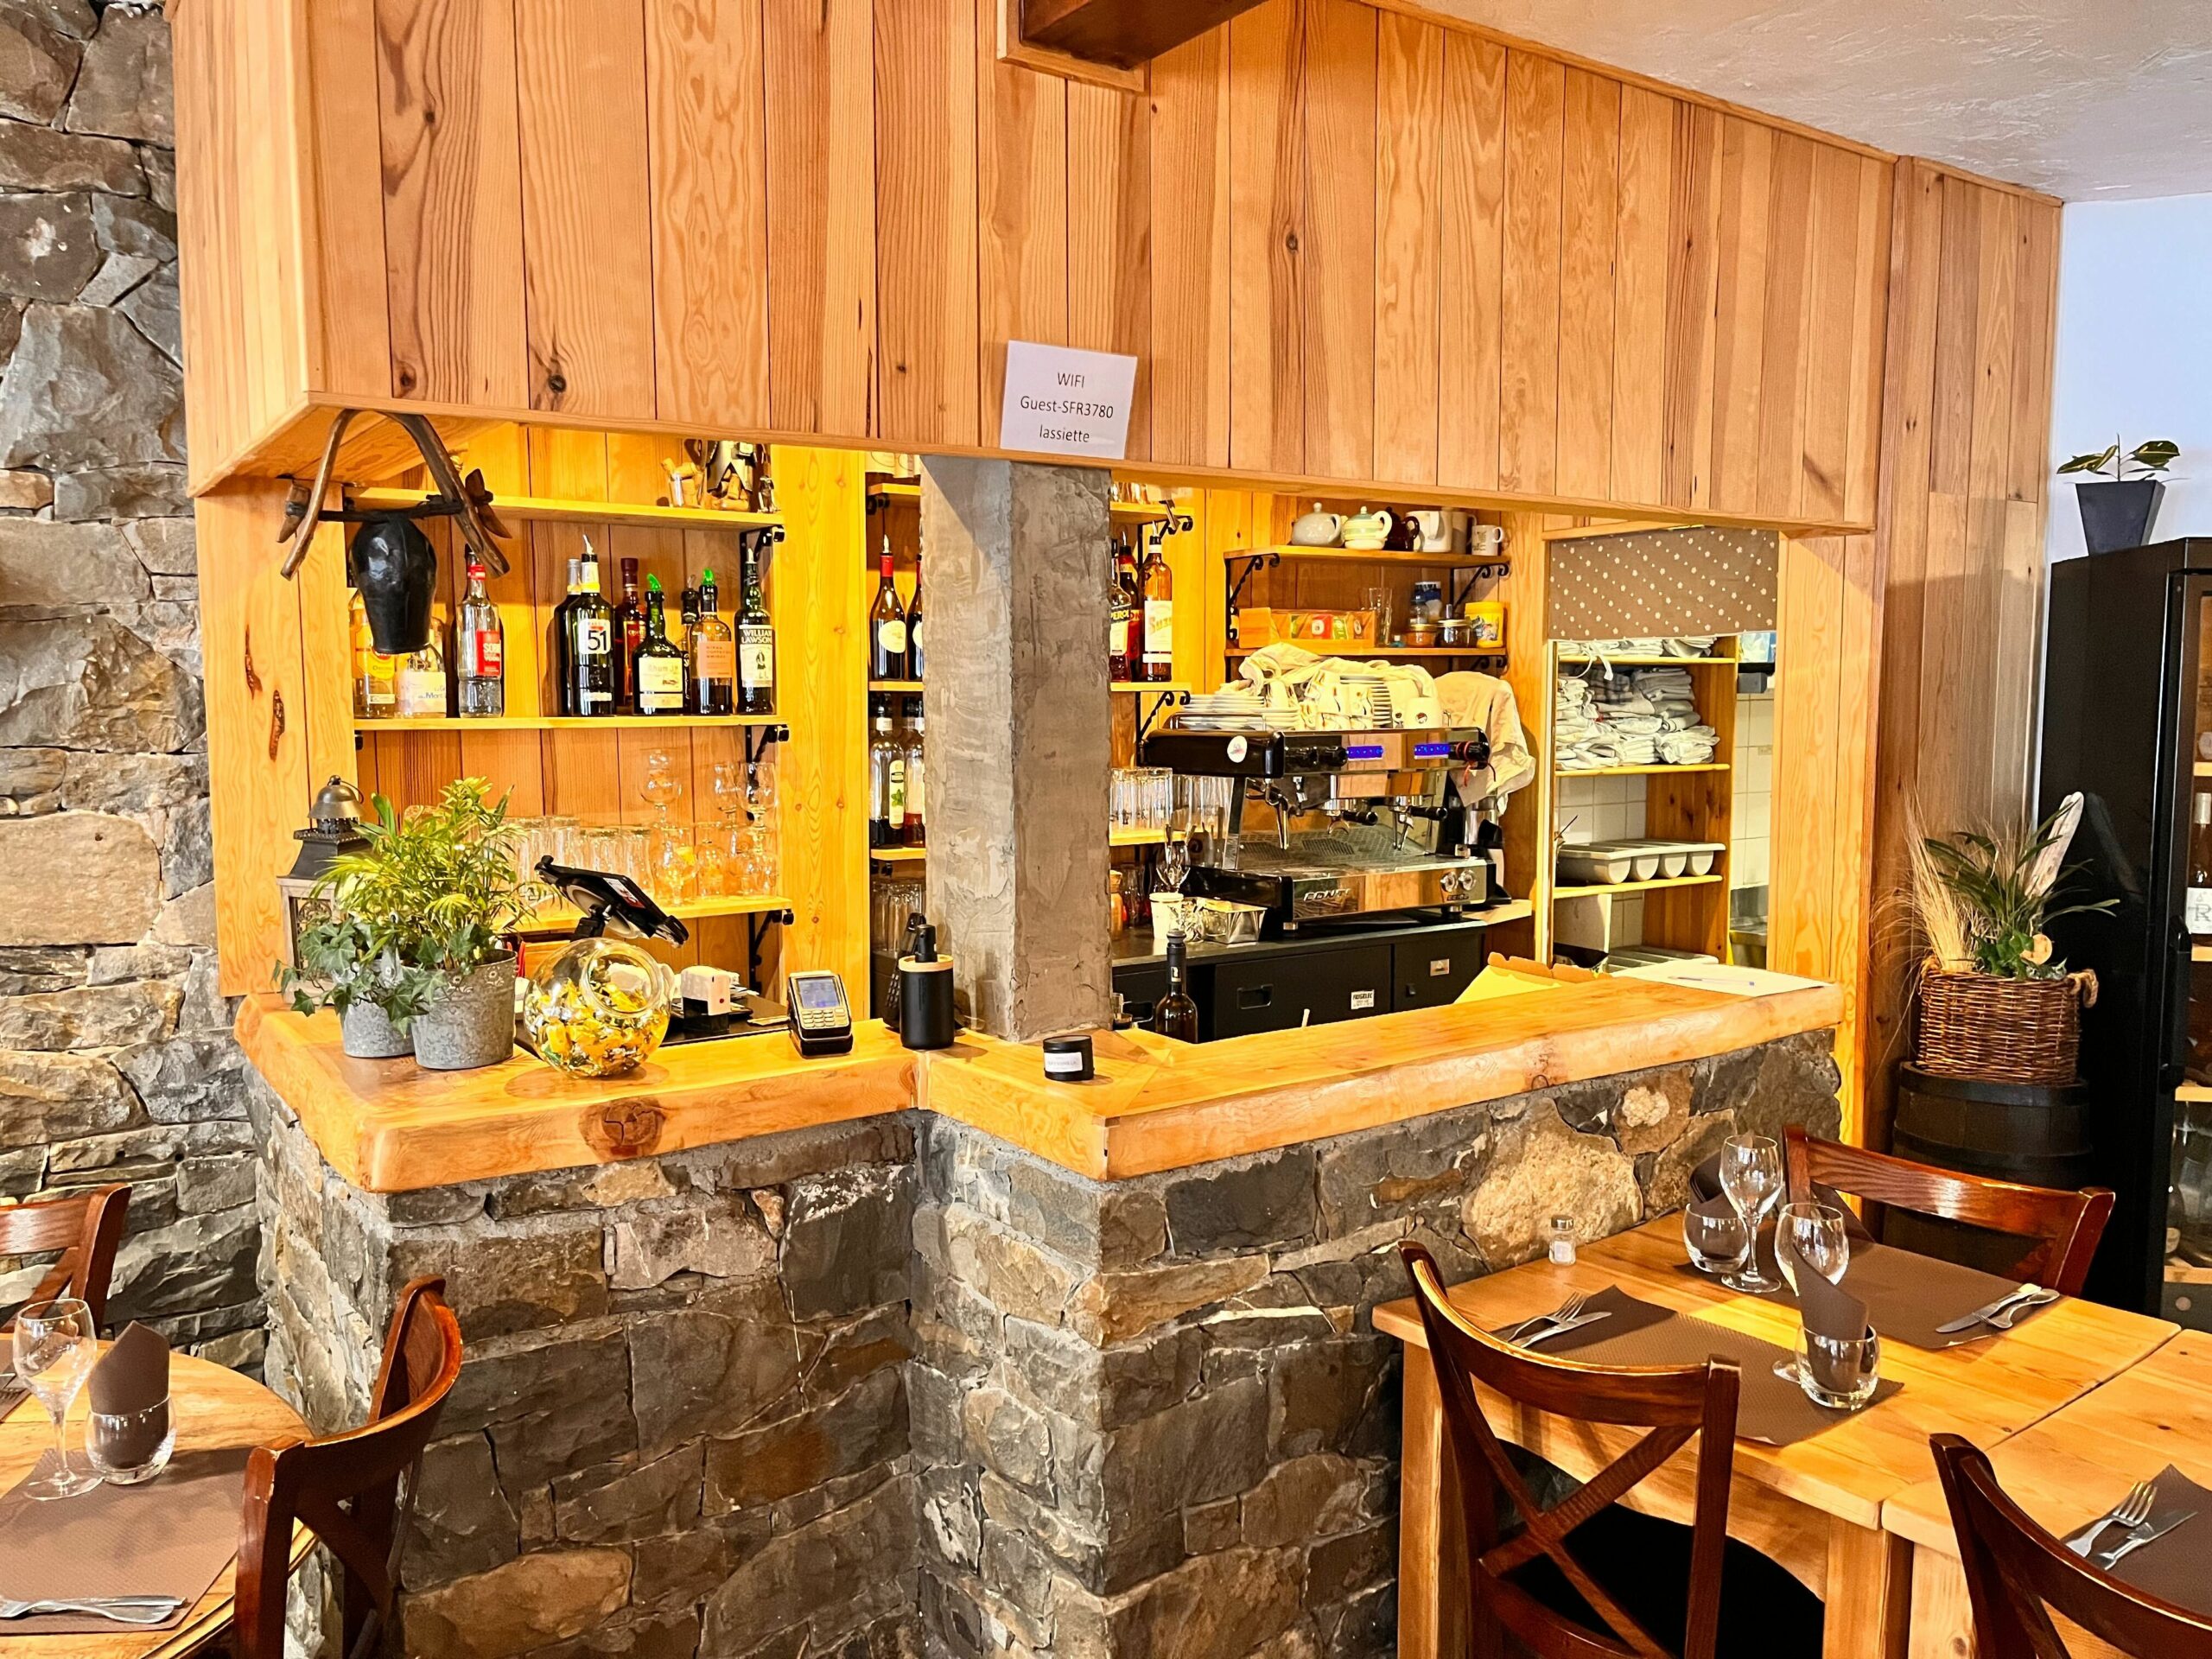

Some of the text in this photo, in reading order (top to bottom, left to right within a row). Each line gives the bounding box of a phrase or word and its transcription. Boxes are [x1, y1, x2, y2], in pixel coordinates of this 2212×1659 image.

[1058, 372, 1085, 388] WIFI
[1020, 396, 1114, 418] Guest-SFR3780
[1039, 424, 1090, 443] lassiette
[588, 630, 607, 651] 51
